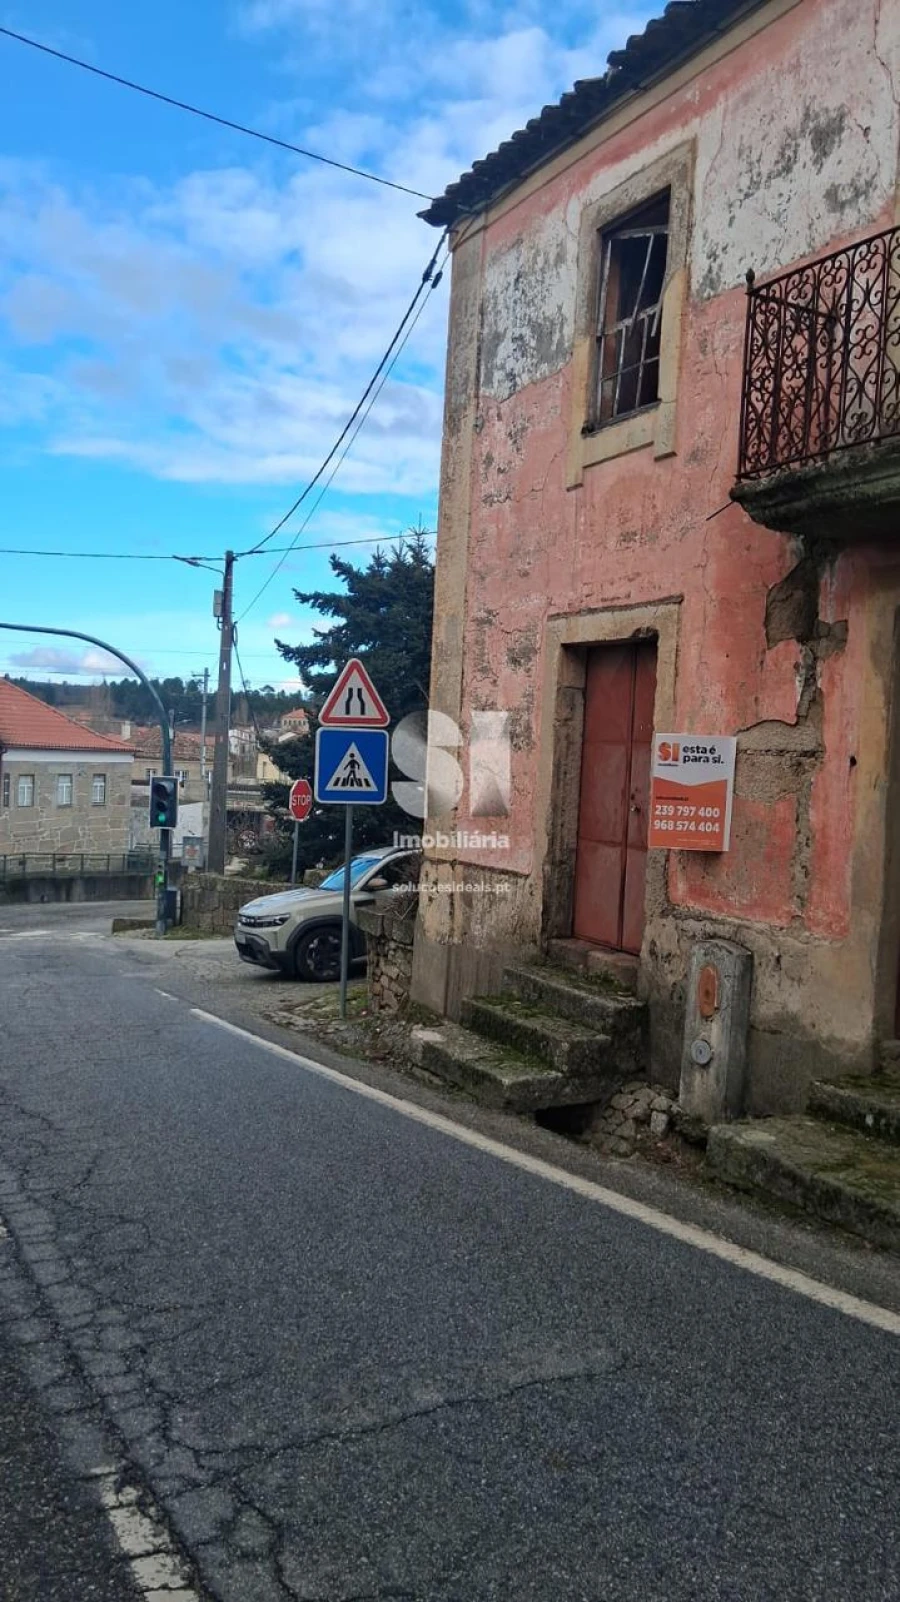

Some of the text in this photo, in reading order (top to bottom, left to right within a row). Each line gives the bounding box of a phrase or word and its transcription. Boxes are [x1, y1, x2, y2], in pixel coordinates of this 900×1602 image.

[682, 745, 716, 755] esta é
[682, 755, 724, 764] para si.
[292, 794, 310, 806] STOP
[655, 805, 720, 818] 239 797 400
[654, 820, 720, 834] 968 574 404
